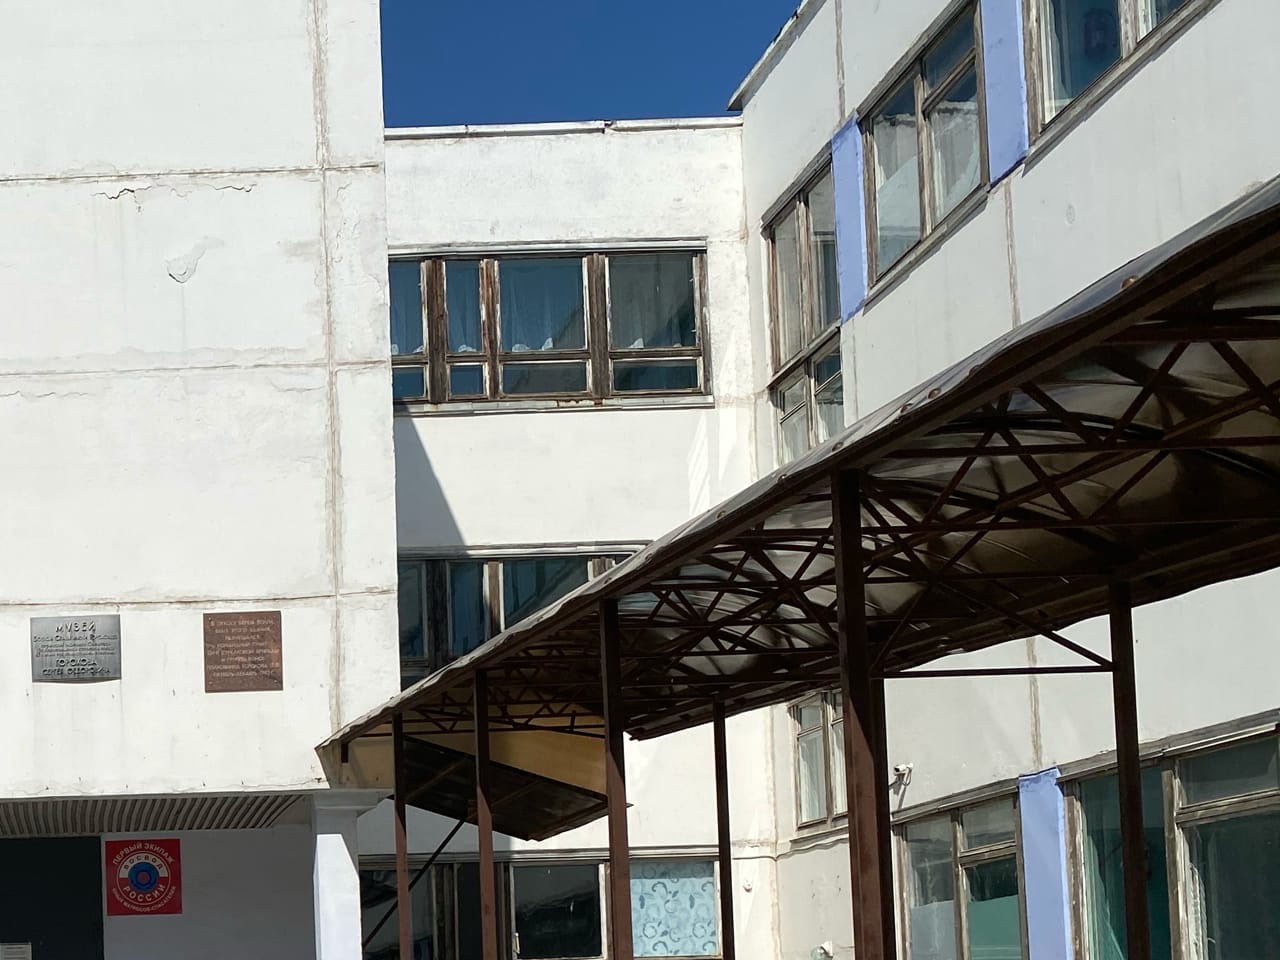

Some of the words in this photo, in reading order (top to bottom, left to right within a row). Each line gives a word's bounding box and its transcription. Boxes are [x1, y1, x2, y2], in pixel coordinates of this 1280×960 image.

[112, 842, 142, 865] ПЕРВЫЙ
[144, 842, 175, 864] ЭКИПАЖ
[124, 854, 163, 870] ВОСВОД
[122, 883, 166, 902] РОССИИ
